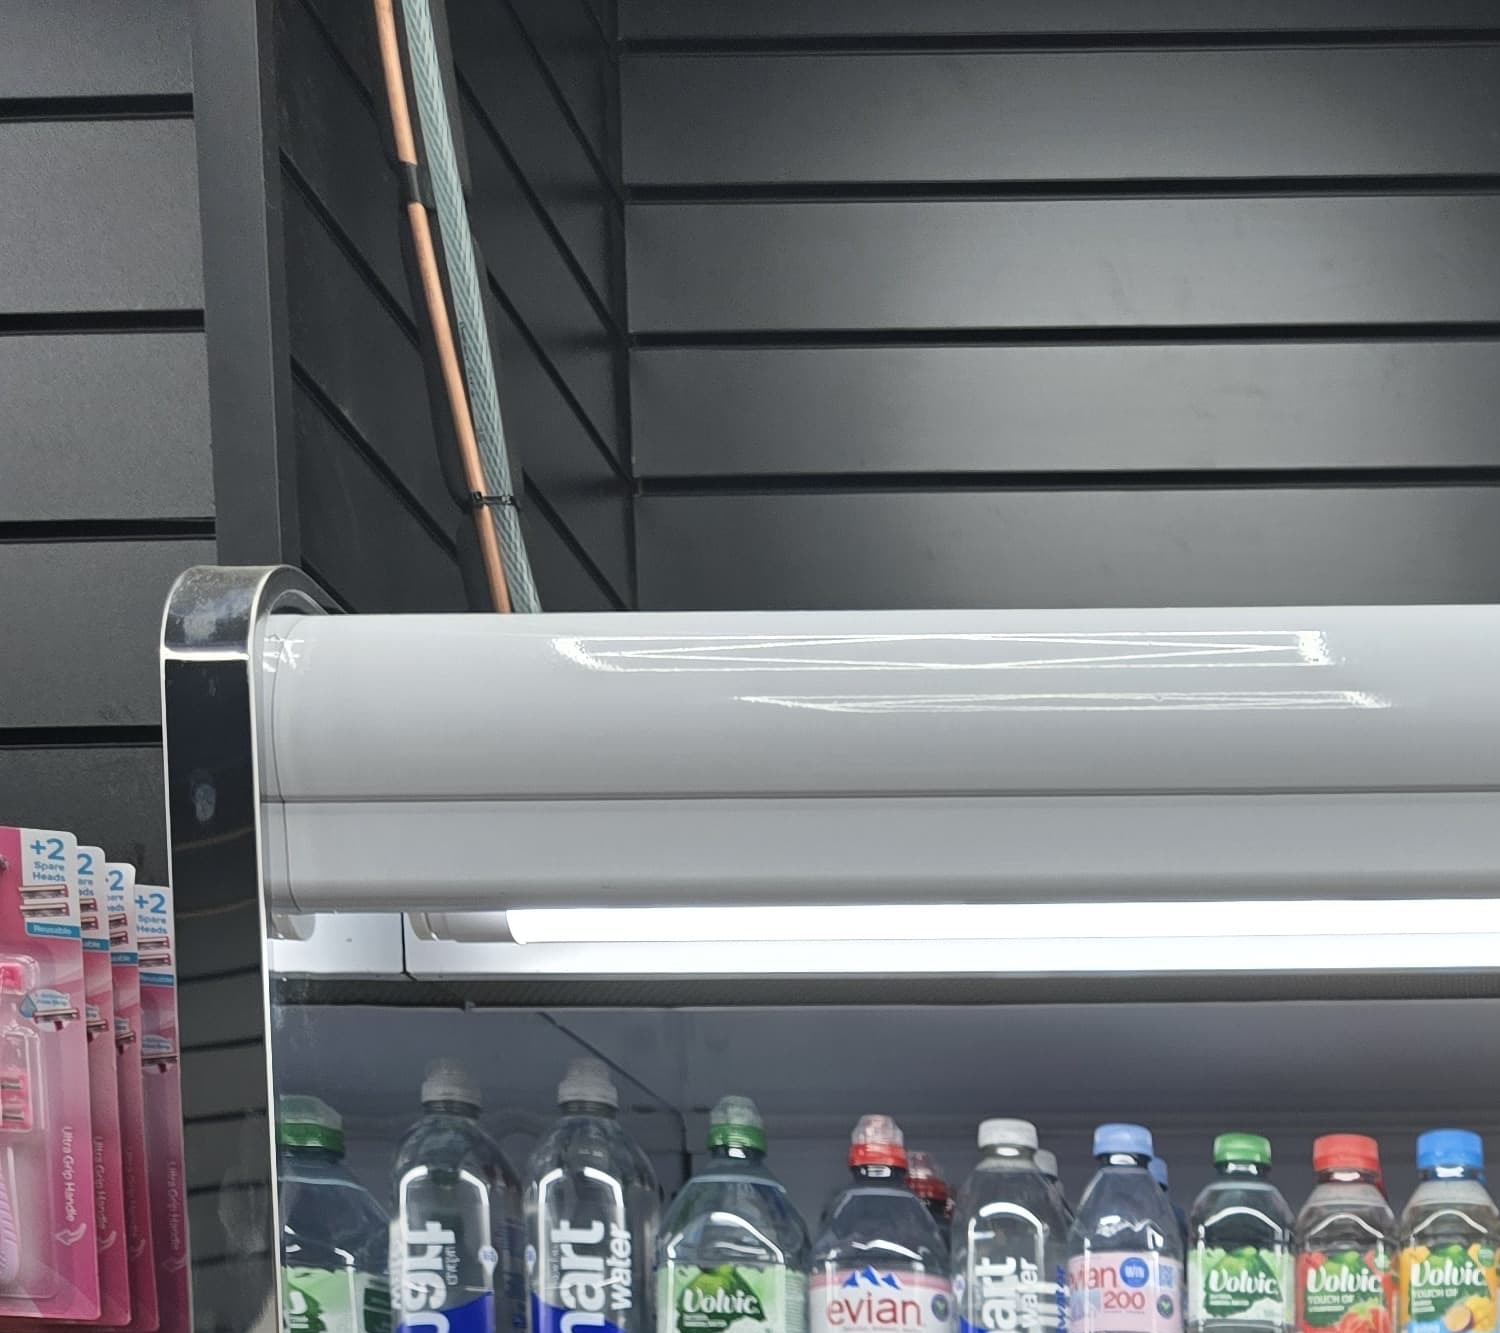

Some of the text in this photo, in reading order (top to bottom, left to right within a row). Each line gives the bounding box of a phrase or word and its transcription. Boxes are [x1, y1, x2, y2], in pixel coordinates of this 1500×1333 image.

[30, 838, 65, 861] +2
[33, 871, 66, 882] Heads
[34, 861, 65, 871] Spare
[135, 893, 167, 914] +2
[137, 924, 168, 934] Heads
[138, 914, 167, 924] Spare
[609, 1228, 633, 1312] water
[1305, 1265, 1383, 1294] Volvic
[1207, 1268, 1281, 1298] Volvic
[679, 1285, 760, 1317] Volvic
[826, 1292, 923, 1328] evian
[1103, 1291, 1147, 1311] 200
